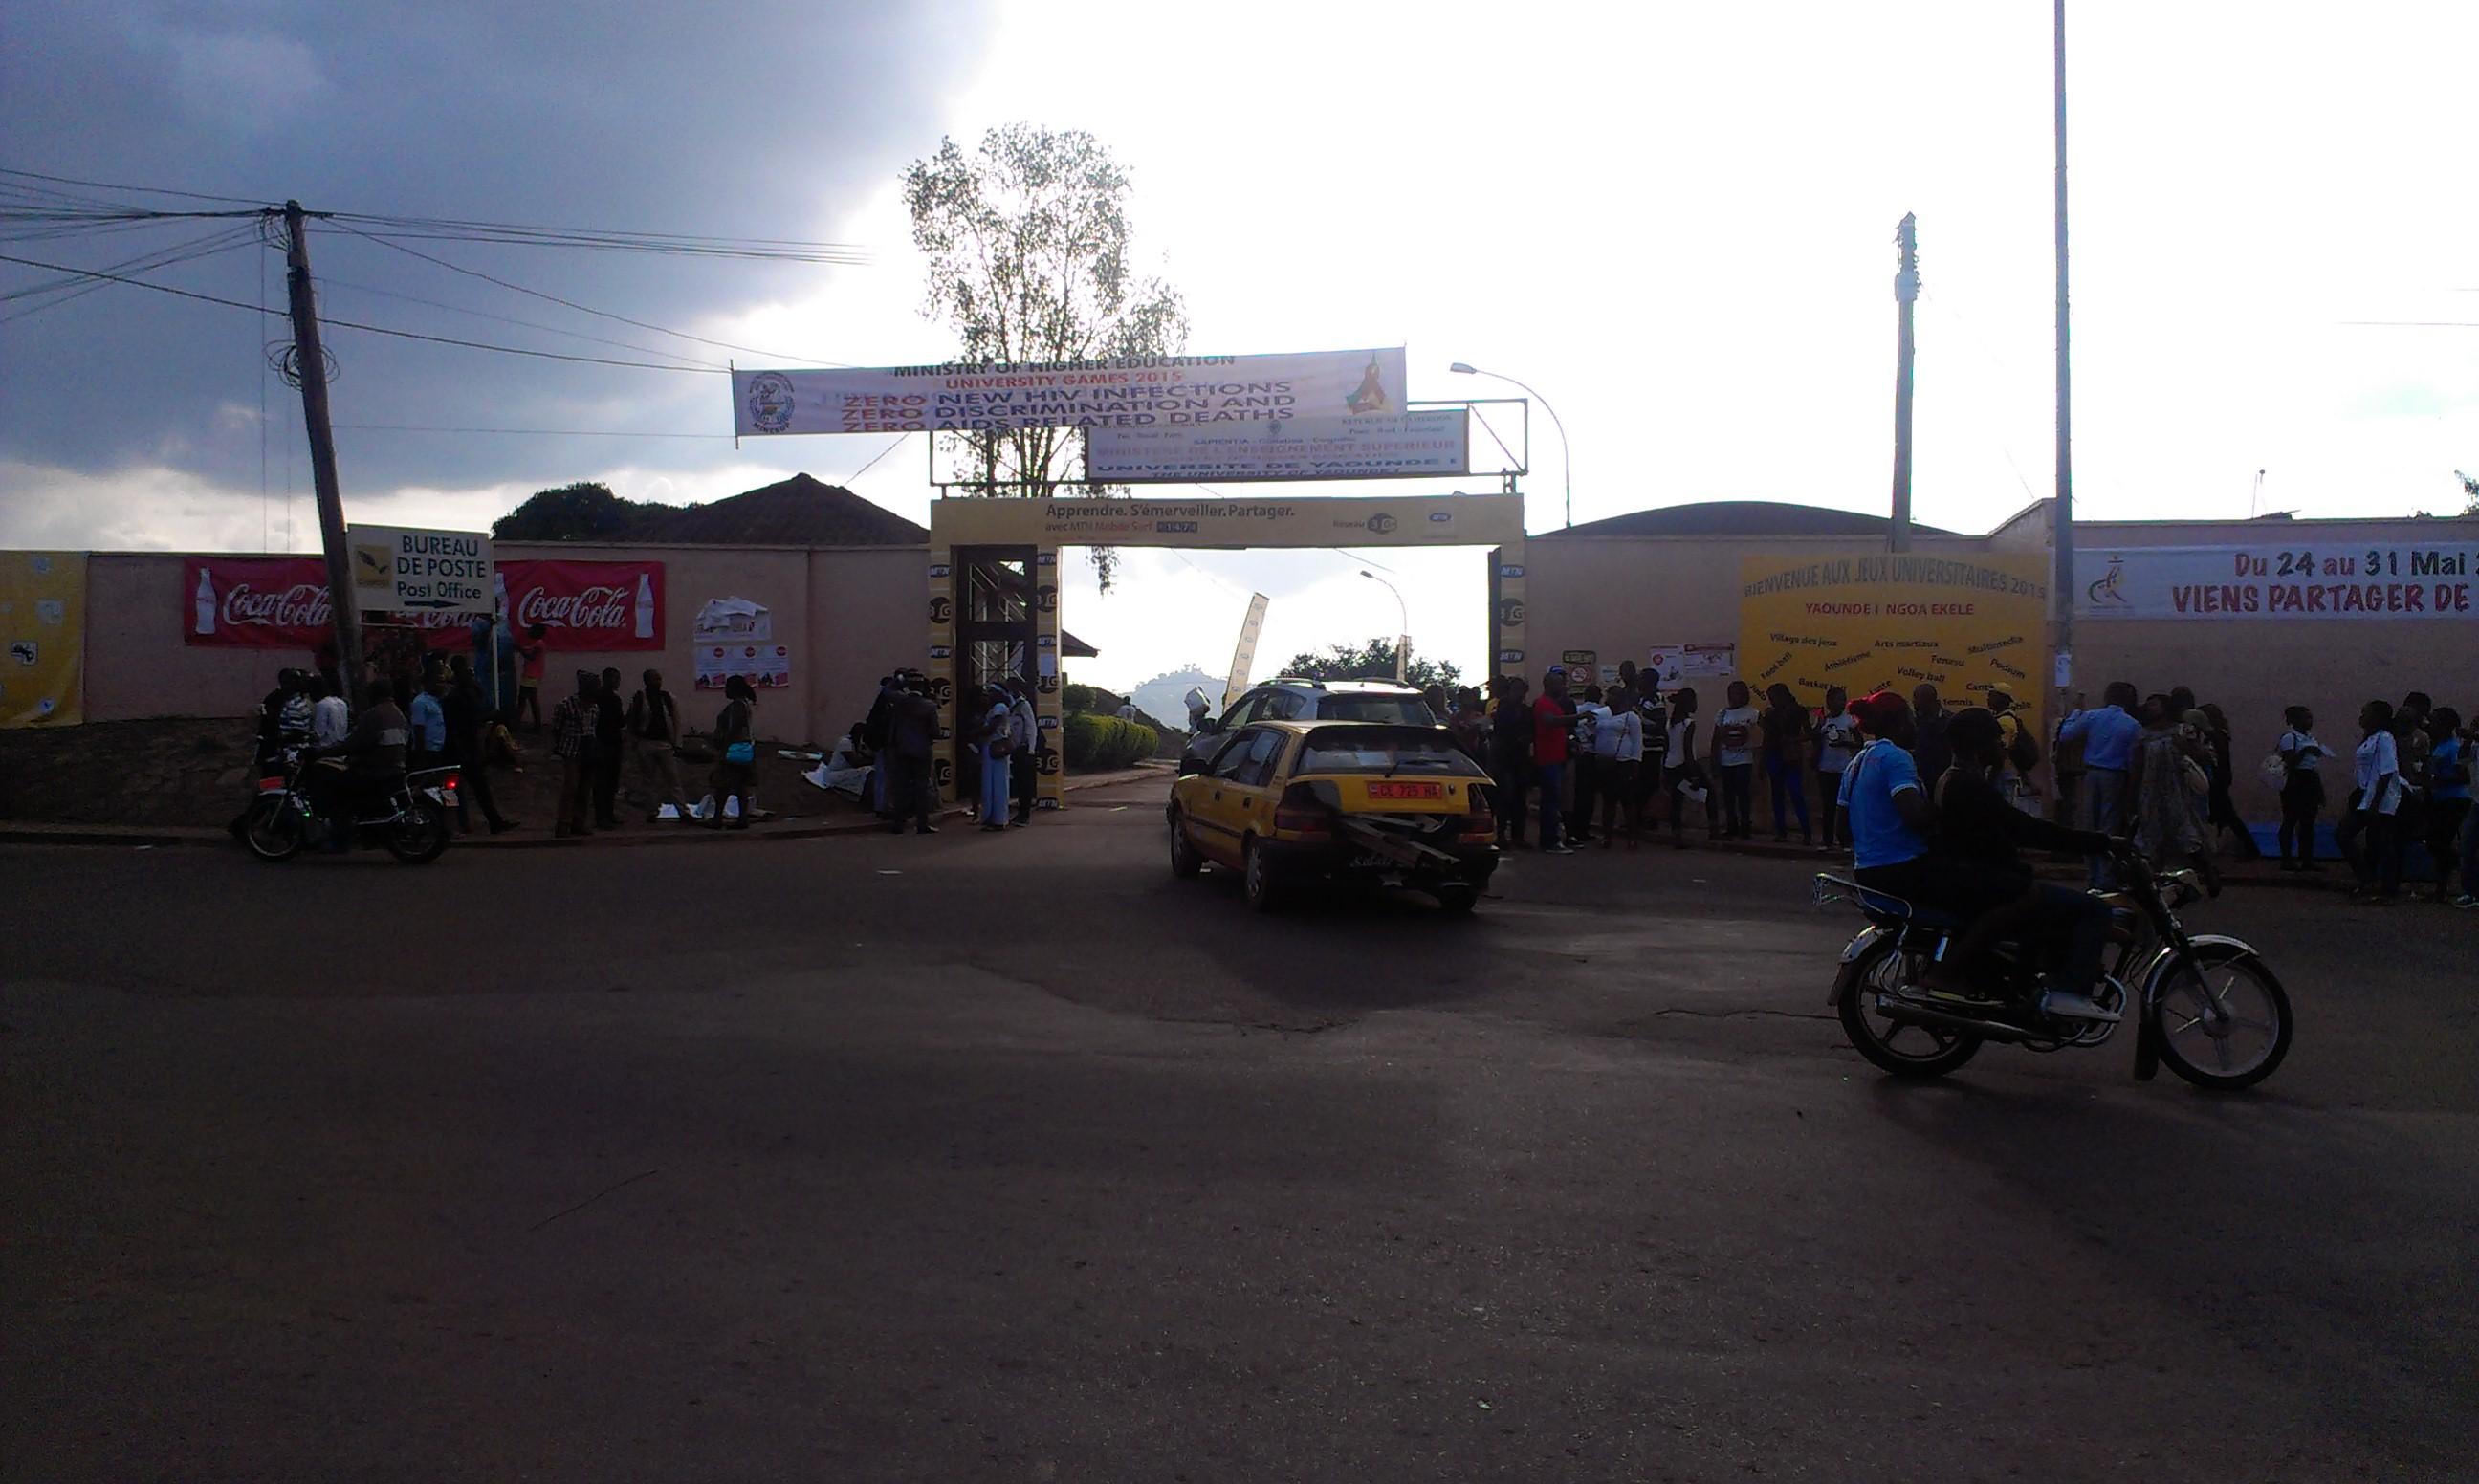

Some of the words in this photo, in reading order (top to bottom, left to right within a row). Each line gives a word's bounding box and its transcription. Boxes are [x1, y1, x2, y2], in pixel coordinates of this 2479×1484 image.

[894, 363, 989, 377] MINISTRY
[996, 362, 1021, 374] OF
[1029, 360, 1108, 373] HIGHER
[1115, 356, 1235, 370] EDUCATION
[946, 376, 1056, 389] UNIVERSITY
[1063, 373, 1128, 385] GAMES
[1136, 371, 1182, 383] 2015
[843, 393, 927, 406] ZERO
[938, 390, 1014, 404] NEW
[1025, 388, 1080, 402] HIV
[1093, 381, 1291, 400] INFECTIONS
[841, 407, 924, 420] ZERO
[935, 397, 1210, 418] DISCRIMINATION
[1221, 394, 1295, 407] AND
[841, 421, 925, 433] ZERO
[938, 418, 1011, 430] AIDS
[1023, 414, 1156, 428] RELATED
[1171, 407, 1293, 424] DEATHS
[1046, 503, 1128, 519] Apprendre.
[1228, 503, 1295, 519] Partager.
[402, 535, 478, 556] BUREAU
[397, 556, 422, 576] DE
[428, 558, 486, 578] POSTE
[2235, 553, 2268, 577] Du
[2277, 551, 2315, 577] 24
[2323, 557, 2355, 576] au
[2365, 550, 2398, 576] 31
[2411, 551, 2466, 576] Mai
[1744, 564, 1818, 598] BIENVENUE
[1822, 559, 1851, 585] AUX
[1891, 556, 2007, 593] UNIVERSITAIRES
[397, 580, 430, 597] Post
[437, 581, 482, 599] Office
[2172, 584, 2259, 613] VIENS
[2268, 583, 2425, 613] PARTAGER
[2434, 583, 2469, 613] DE
[1806, 602, 1872, 616] YAOUNDE
[1886, 602, 1928, 616] NGOA
[1931, 602, 1975, 616] EKELE
